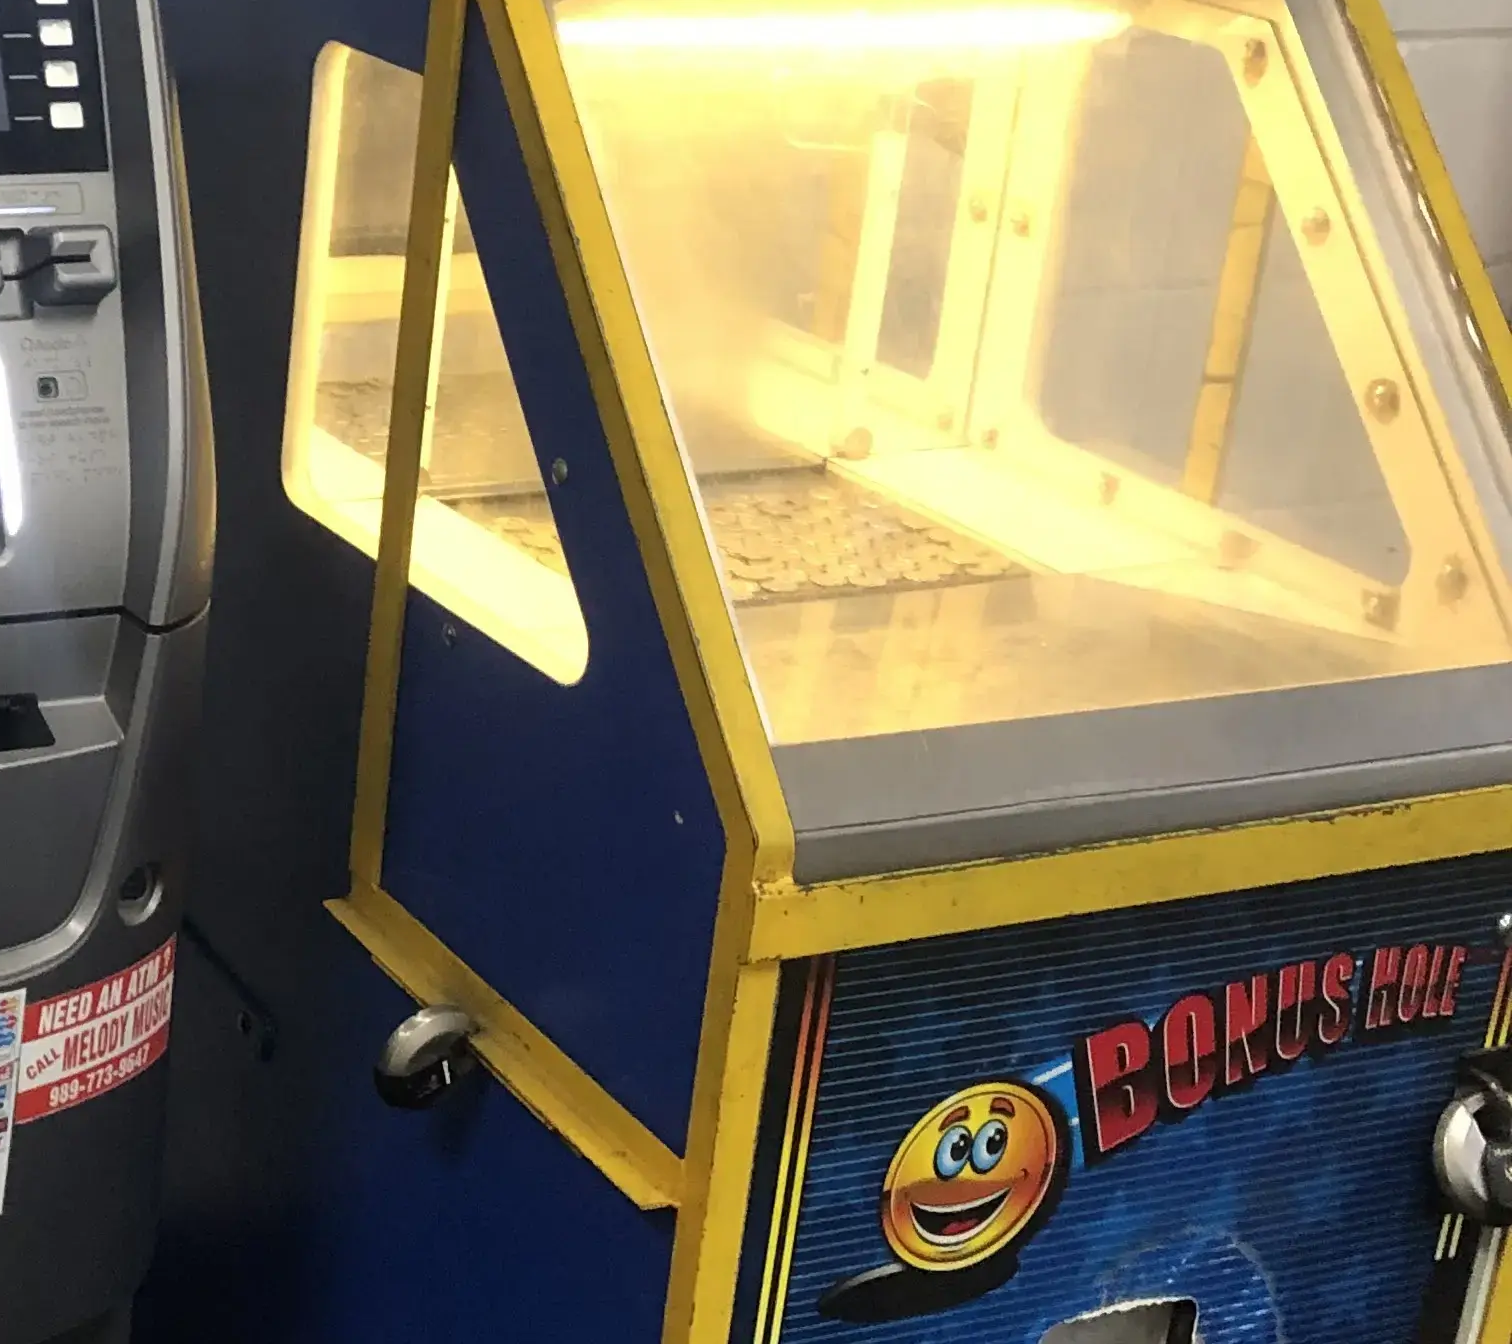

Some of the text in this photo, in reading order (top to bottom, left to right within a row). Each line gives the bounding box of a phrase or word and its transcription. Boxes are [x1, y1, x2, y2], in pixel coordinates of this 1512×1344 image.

[26, 1048, 60, 1080] CALL
[62, 1011, 129, 1071] MELODY
[132, 983, 171, 1041] MUSIC
[38, 991, 94, 1035] NEED
[96, 977, 124, 1014] AN
[126, 955, 161, 1001] ATM
[49, 1043, 151, 1107] 989-773-9647
[1085, 943, 1467, 1153] BONUS HOLE
